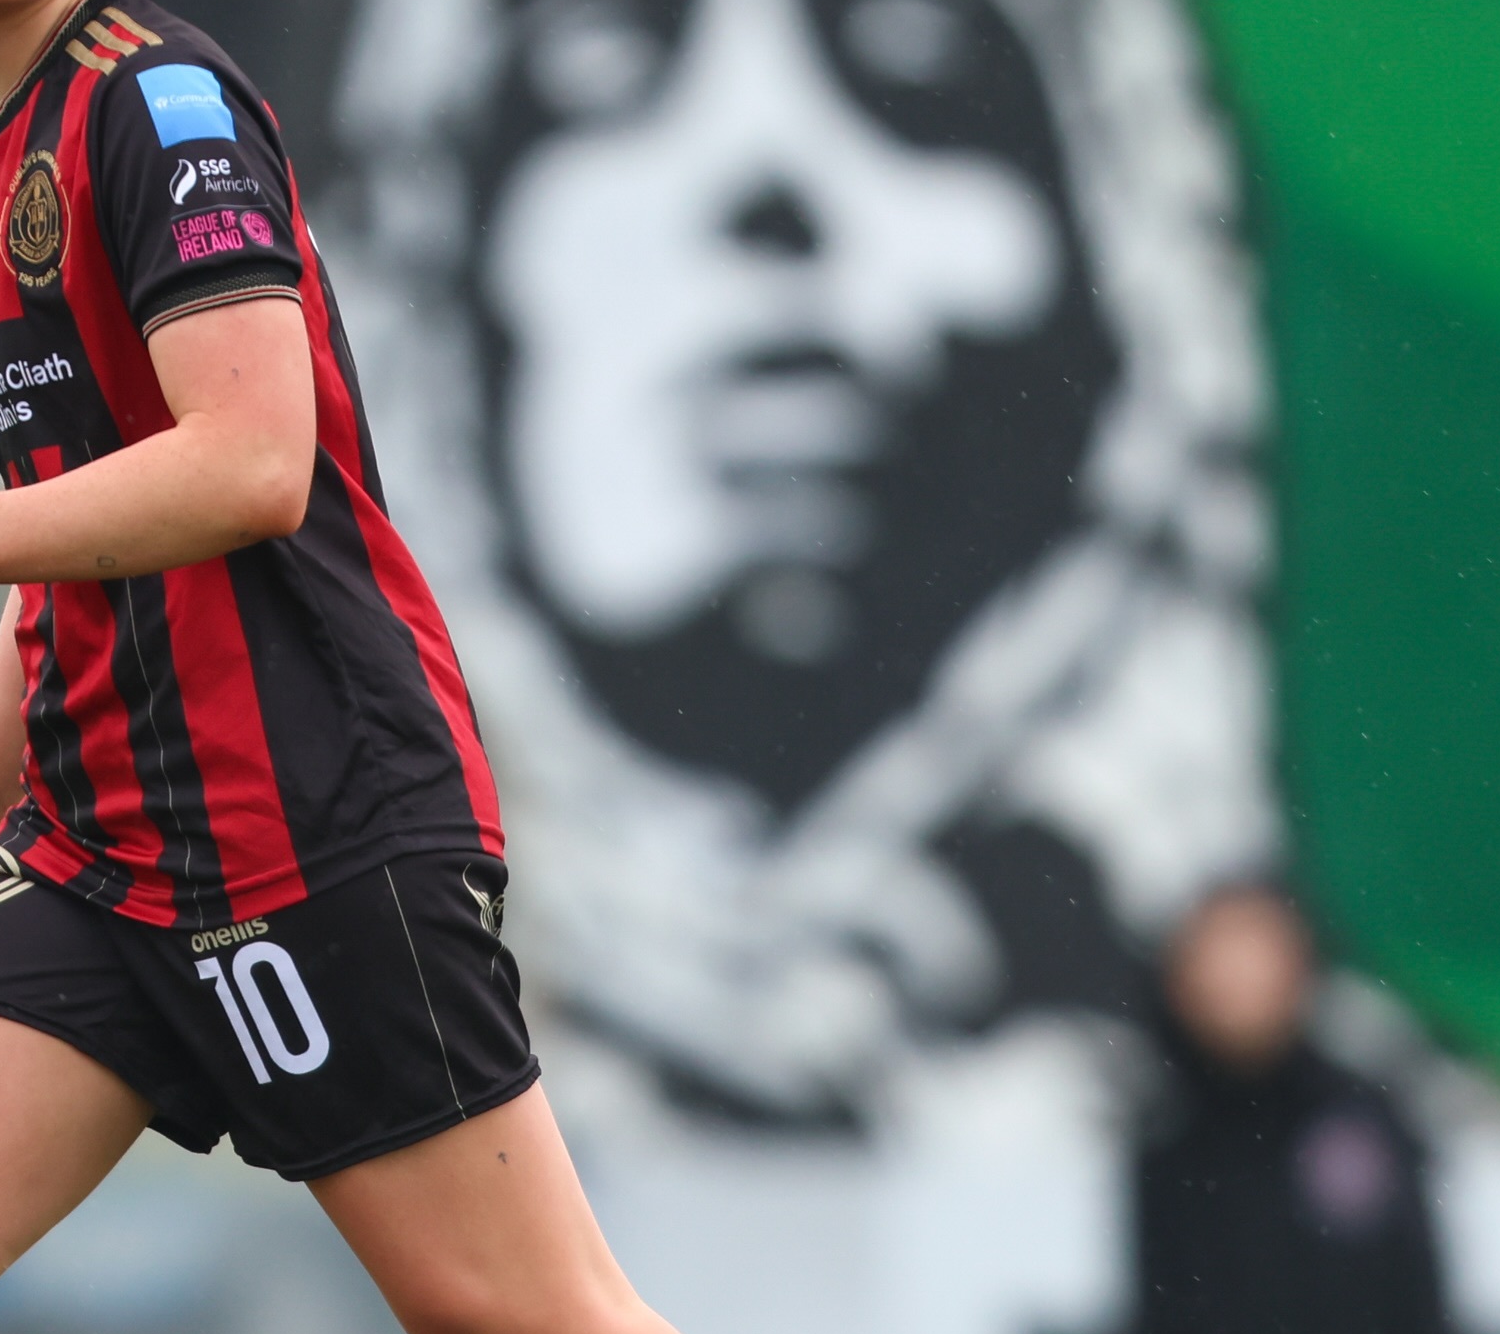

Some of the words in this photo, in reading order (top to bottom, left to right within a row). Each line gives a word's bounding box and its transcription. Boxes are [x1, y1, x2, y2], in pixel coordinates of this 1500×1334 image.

[198, 158, 231, 176] sse
[205, 176, 259, 195] Airtricity
[172, 212, 221, 241] LEAGUE
[220, 210, 238, 228] OF
[177, 229, 244, 263] IRELAND
[35, 267, 58, 287] YEARS
[5, 352, 73, 389] Cliath
[193, 941, 330, 1085] 10
